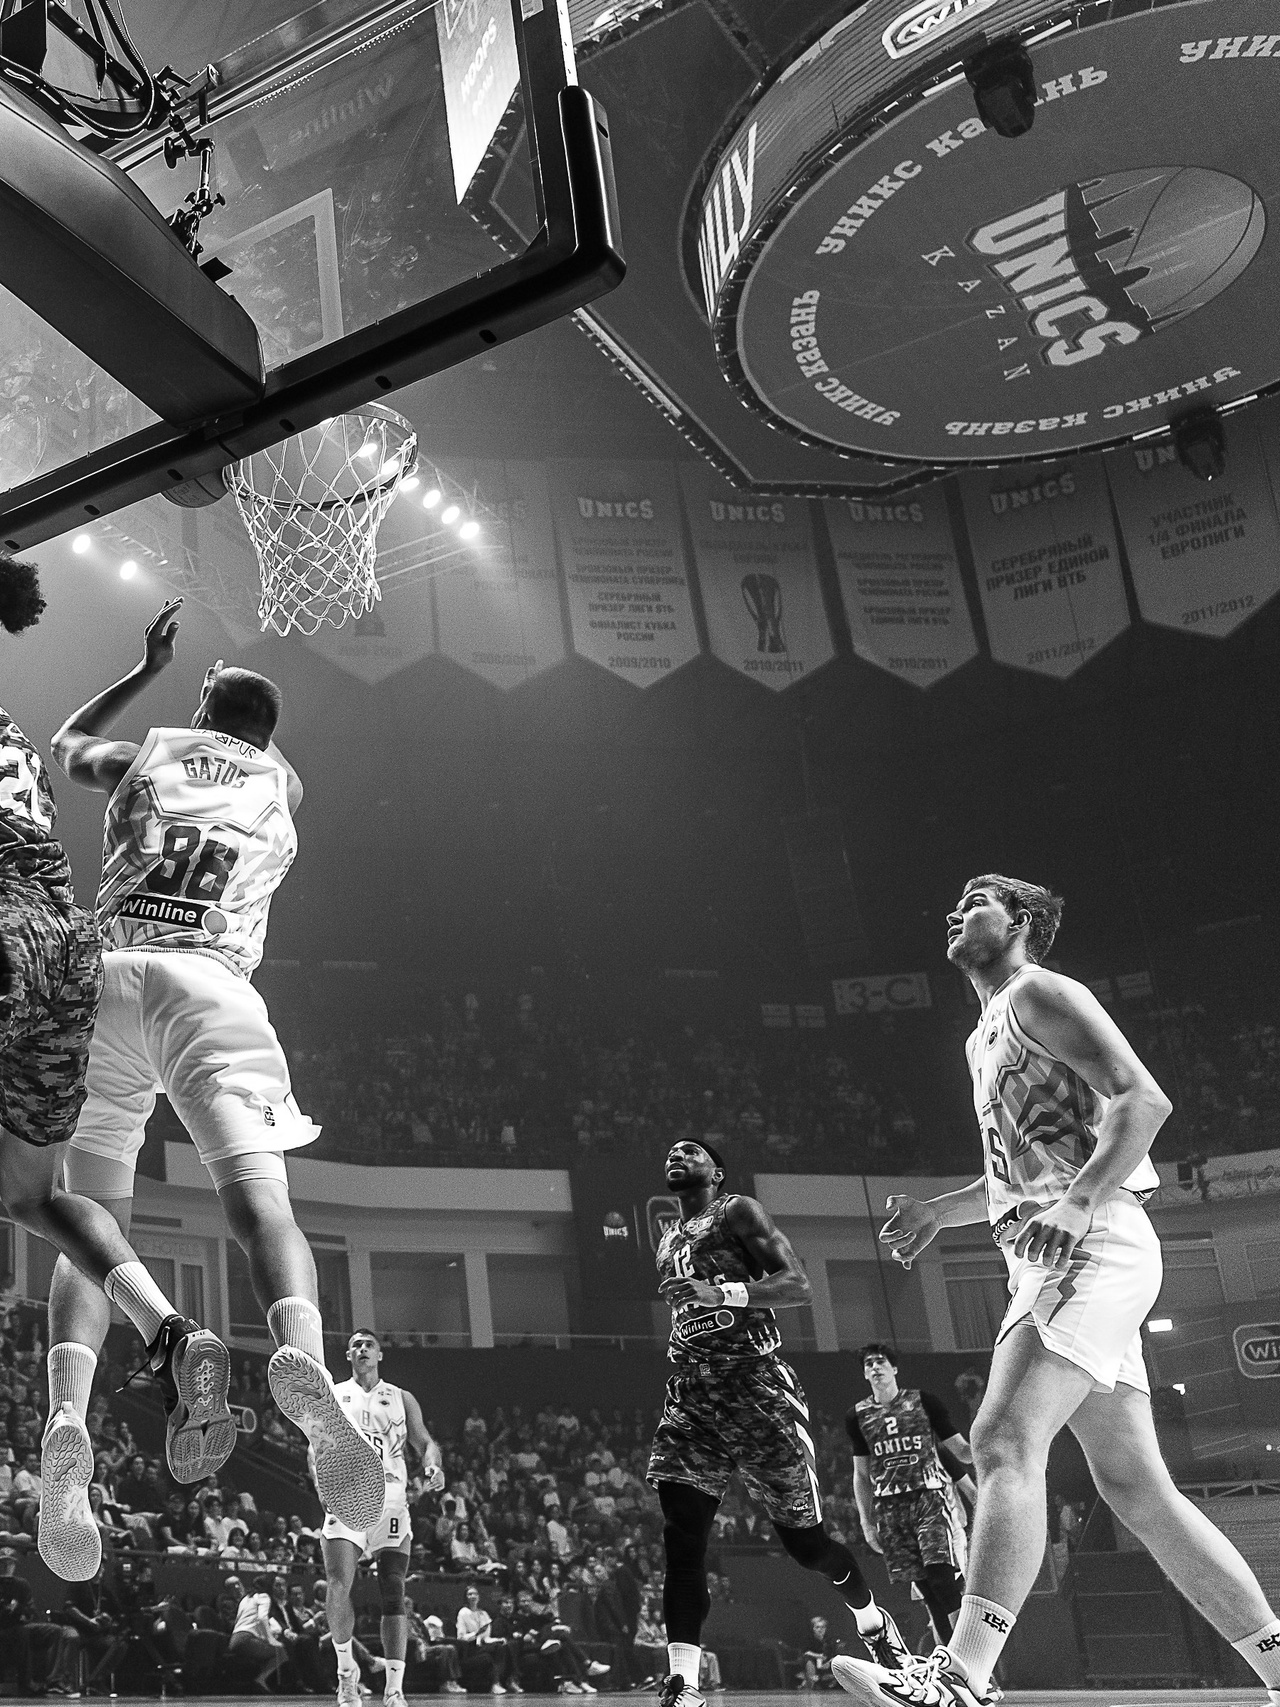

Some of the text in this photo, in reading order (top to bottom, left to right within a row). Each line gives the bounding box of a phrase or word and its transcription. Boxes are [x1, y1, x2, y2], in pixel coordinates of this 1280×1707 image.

[972, 190, 1141, 366] UNICS
[577, 496, 654, 520] UNICS
[990, 472, 1075, 514] UNICS
[709, 500, 785, 523] UNICS
[848, 501, 924, 523] UNICS
[1148, 506, 1248, 547] 1/4 ФИНАЛА
[1150, 492, 1235, 529] УЧАСТНИК
[991, 533, 1094, 574] СЕРЕБРЯНЫЙ
[1160, 523, 1246, 561] ЕВРОЛИГИ
[986, 545, 1111, 592] ПРИЗЕР ЕДИНОЙ
[1013, 570, 1087, 601] ЛИГИ ВТБ
[1181, 594, 1258, 626] 2011/2012
[121, 898, 197, 924] Winline
[673, 1243, 695, 1277] 12
[884, 1416, 898, 1435] 2
[389, 1517, 399, 1533] 8
